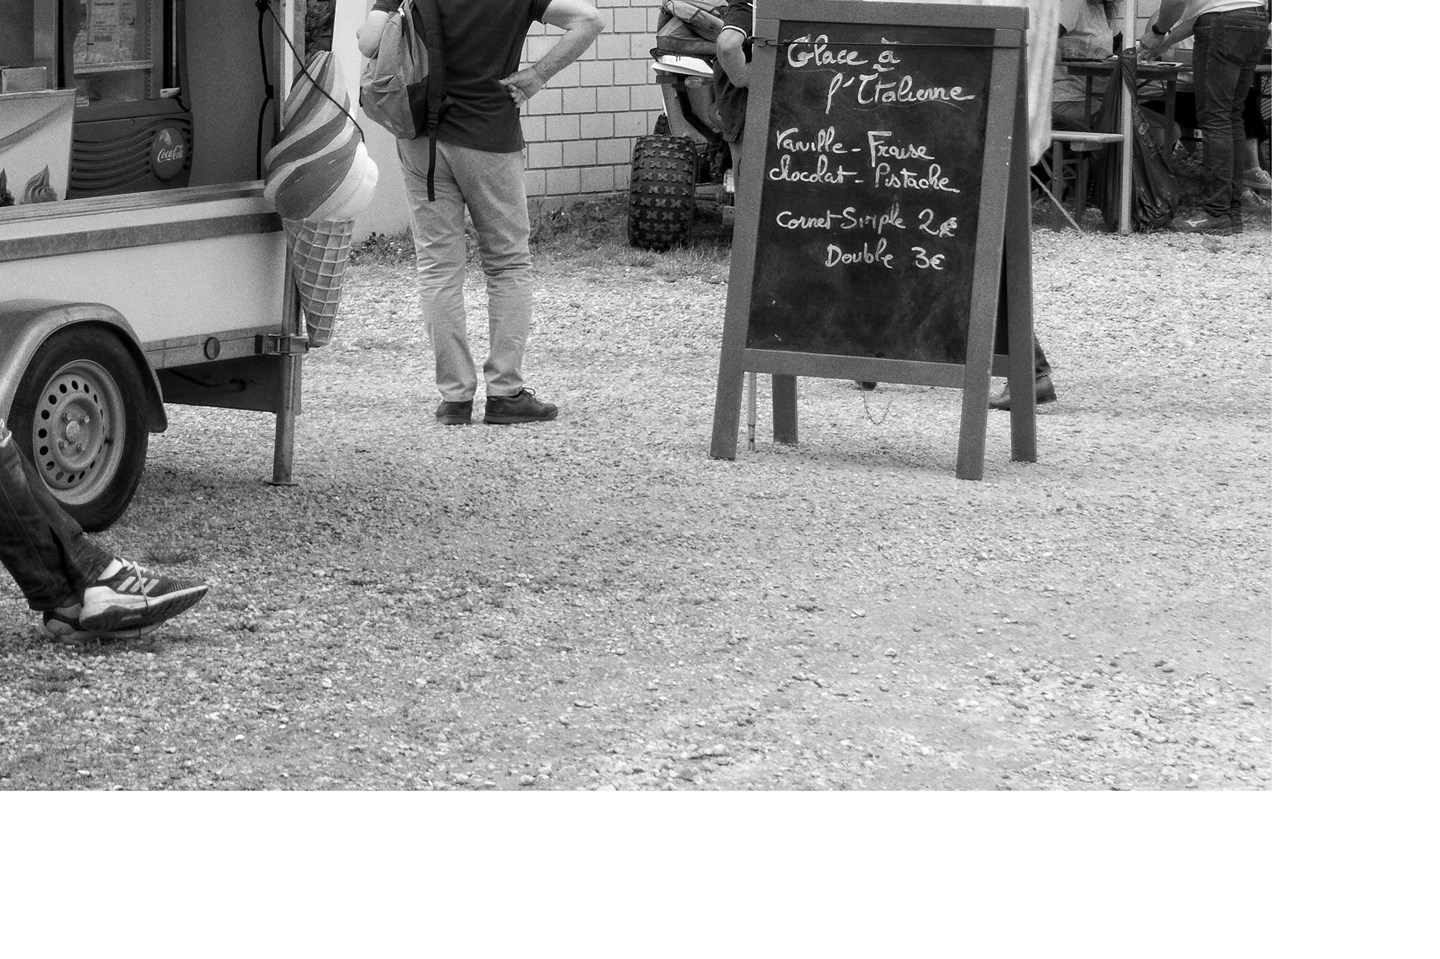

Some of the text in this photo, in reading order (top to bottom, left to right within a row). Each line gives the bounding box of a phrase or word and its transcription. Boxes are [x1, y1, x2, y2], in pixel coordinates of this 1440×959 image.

[787, 34, 901, 68] Glace à
[776, 126, 848, 153] Vanille
[867, 130, 935, 168] Fraise
[875, 162, 961, 194] Pistache
[825, 237, 946, 270] Double 3€
